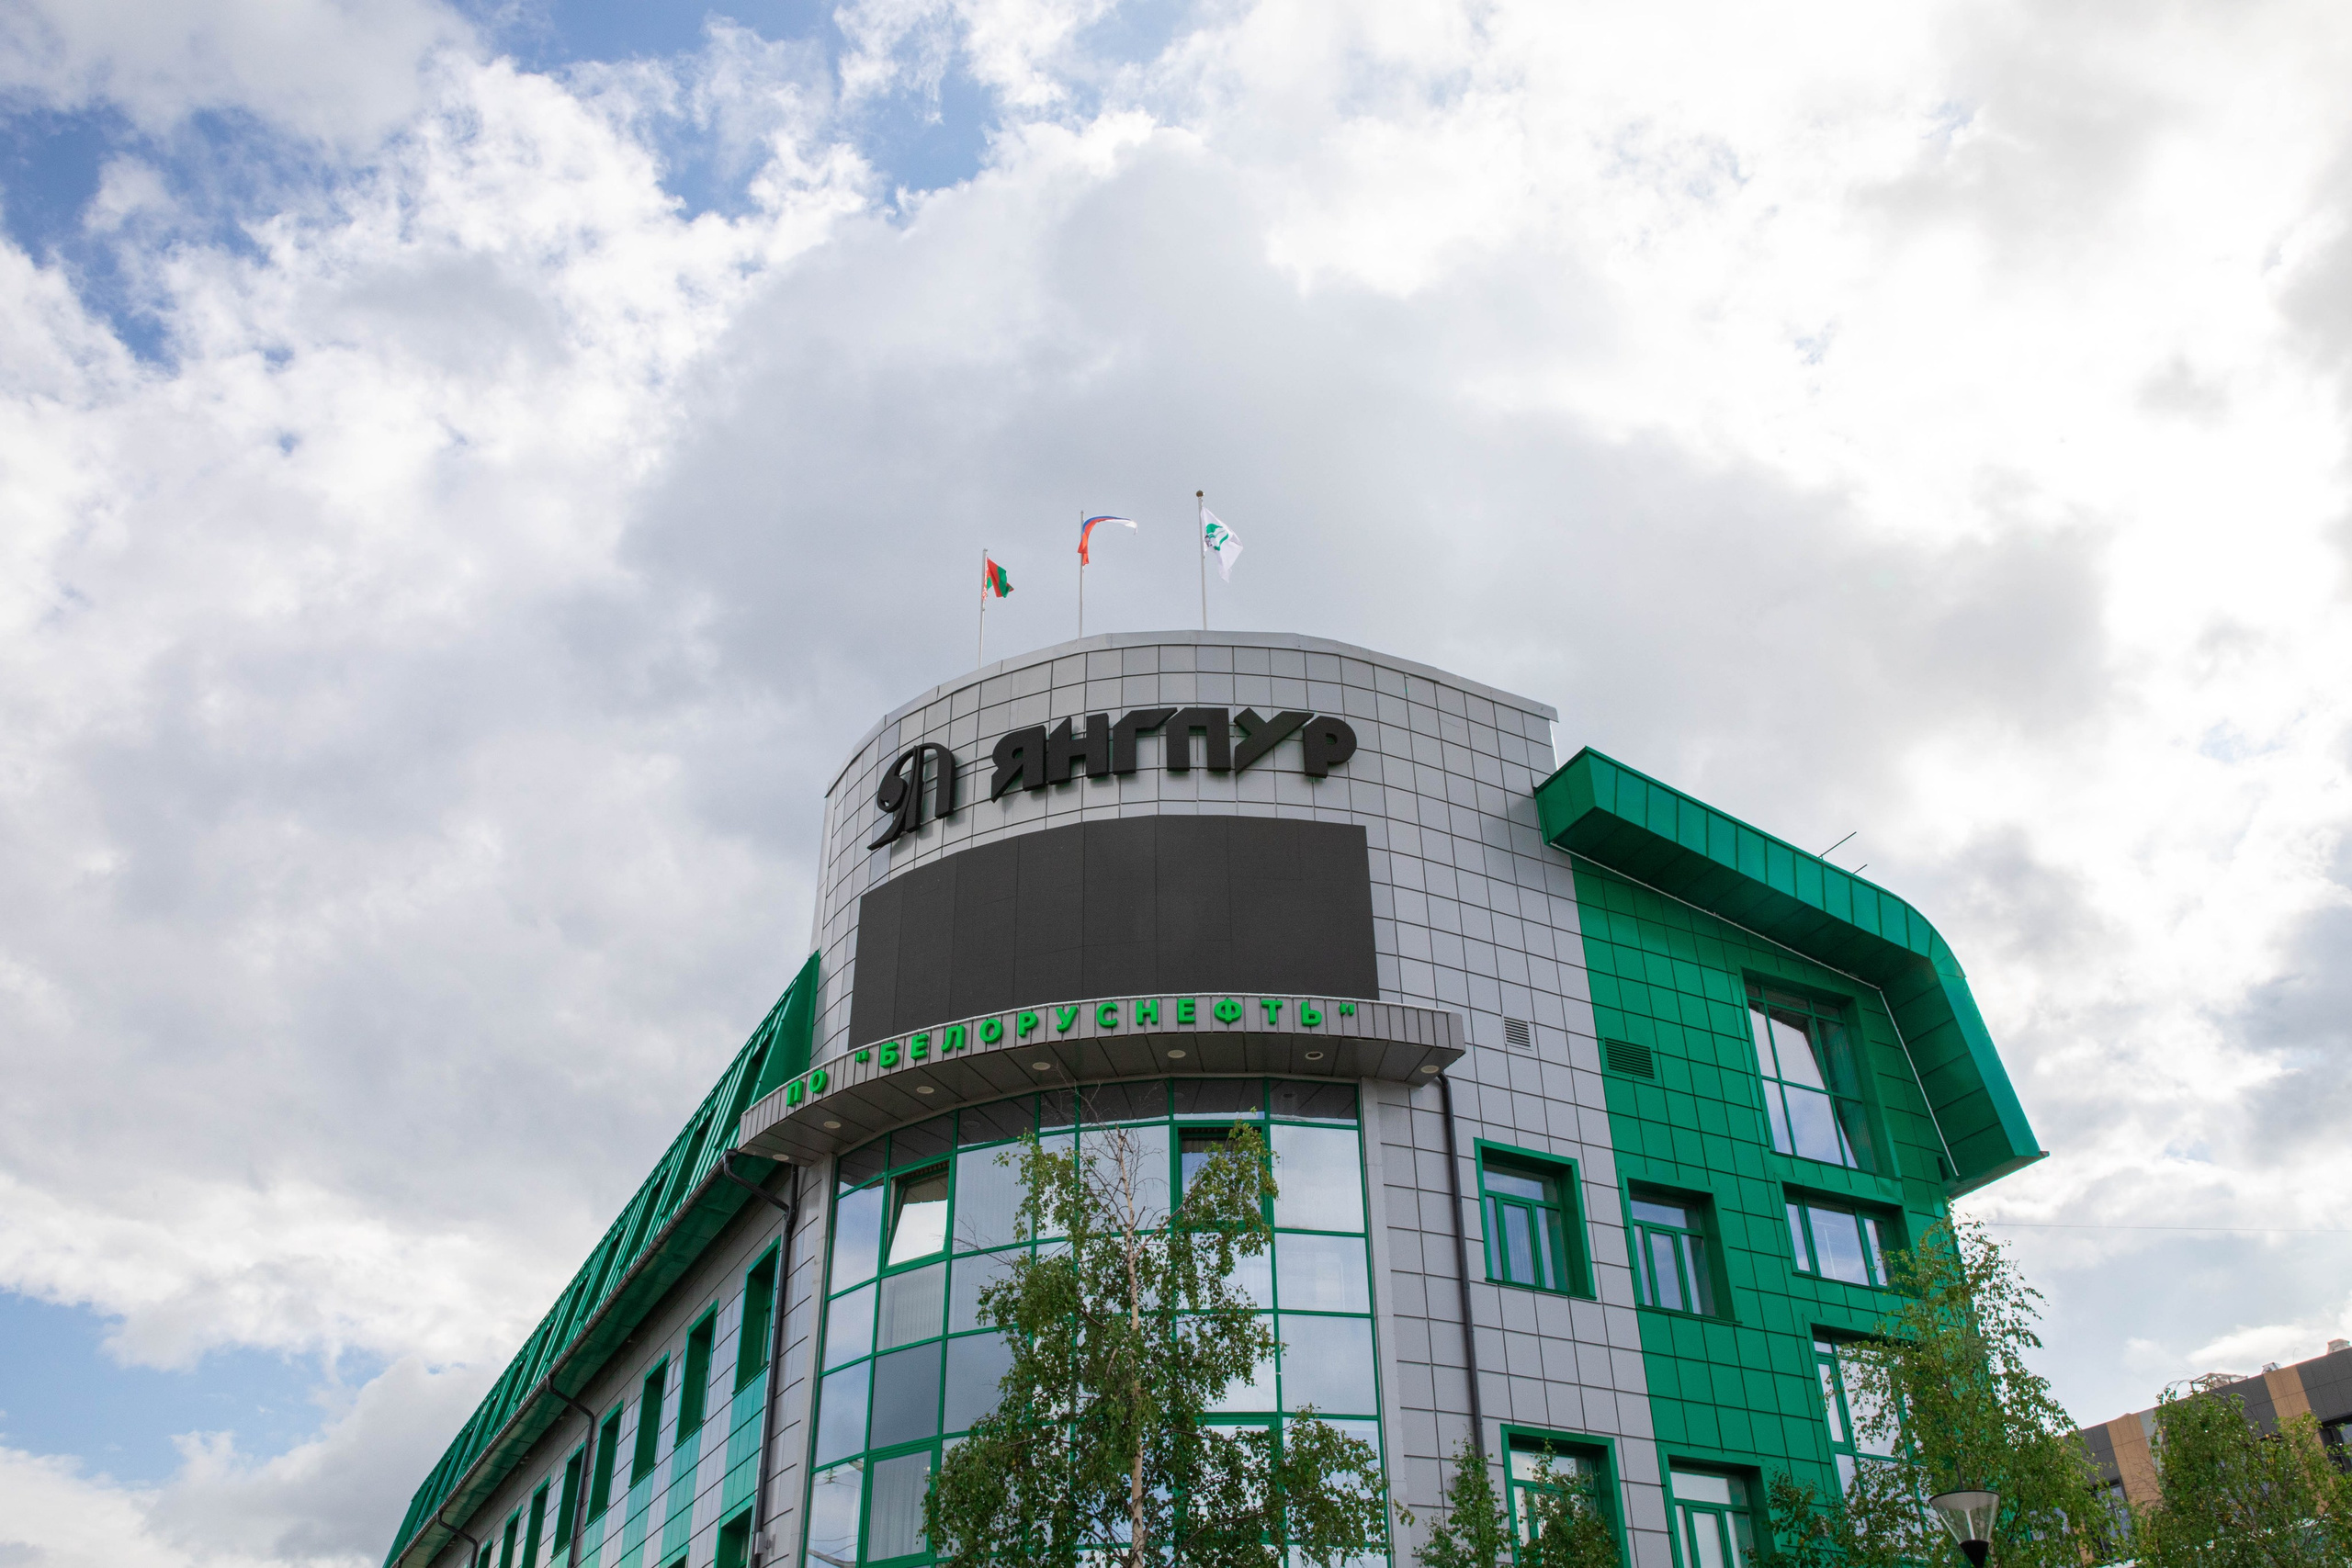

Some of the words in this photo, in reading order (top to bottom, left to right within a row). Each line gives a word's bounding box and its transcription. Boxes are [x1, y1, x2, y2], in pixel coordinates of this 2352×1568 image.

[990, 706, 1358, 803] ЯНГПУР
[786, 1070, 828, 1107] ПО
[855, 998, 1355, 1068] "БЕЛОРУСНЕФТЬ"
